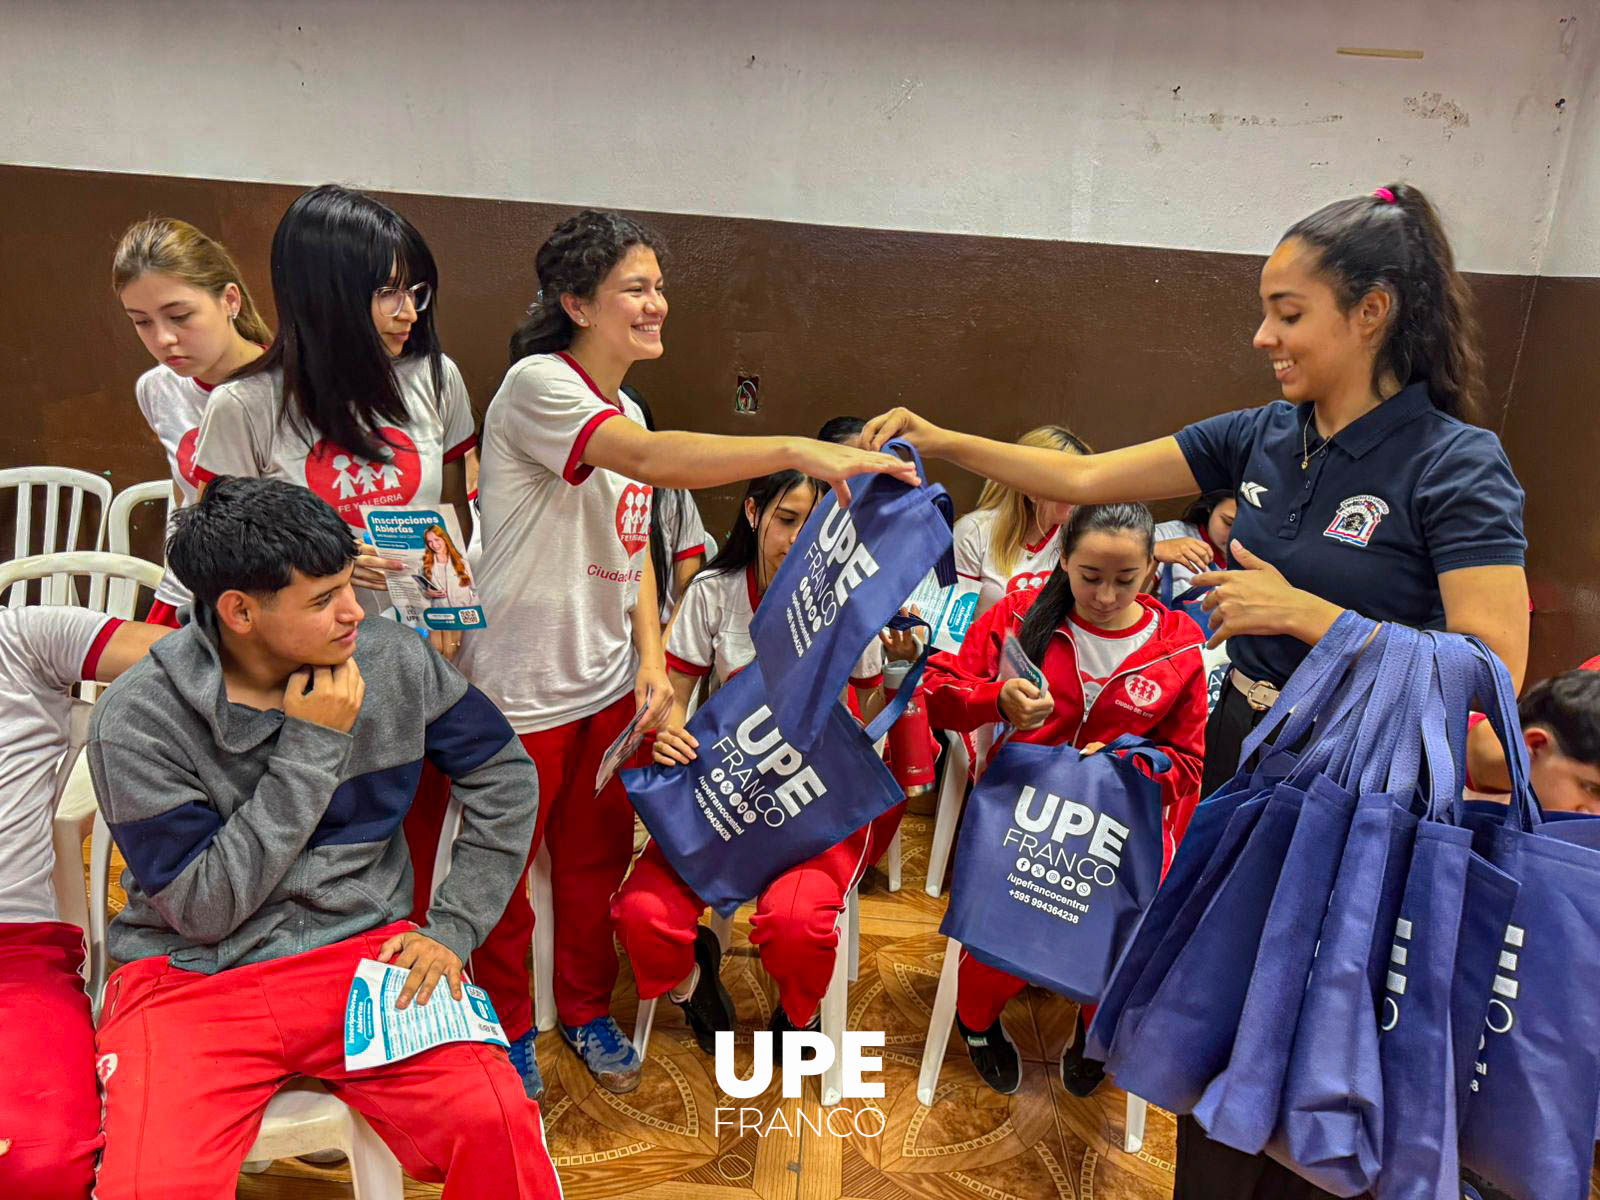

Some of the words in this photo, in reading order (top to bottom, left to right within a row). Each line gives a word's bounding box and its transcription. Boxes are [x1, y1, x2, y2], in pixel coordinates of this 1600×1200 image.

[338, 504, 351, 513] FE
[360, 492, 403, 507] ALEGRIA
[371, 515, 439, 526] Inscripciones
[375, 524, 414, 534] Abiertas
[819, 500, 880, 607] UPE
[804, 541, 837, 626] FRANCO
[711, 736, 785, 827] FRANCO
[736, 704, 828, 818] UPE
[1014, 785, 1130, 868] UPE
[1003, 828, 1116, 887] FRANCO
[1007, 872, 1090, 913] /upefrancocentral
[1008, 889, 1031, 904] +595
[1031, 898, 1080, 925] 994364238
